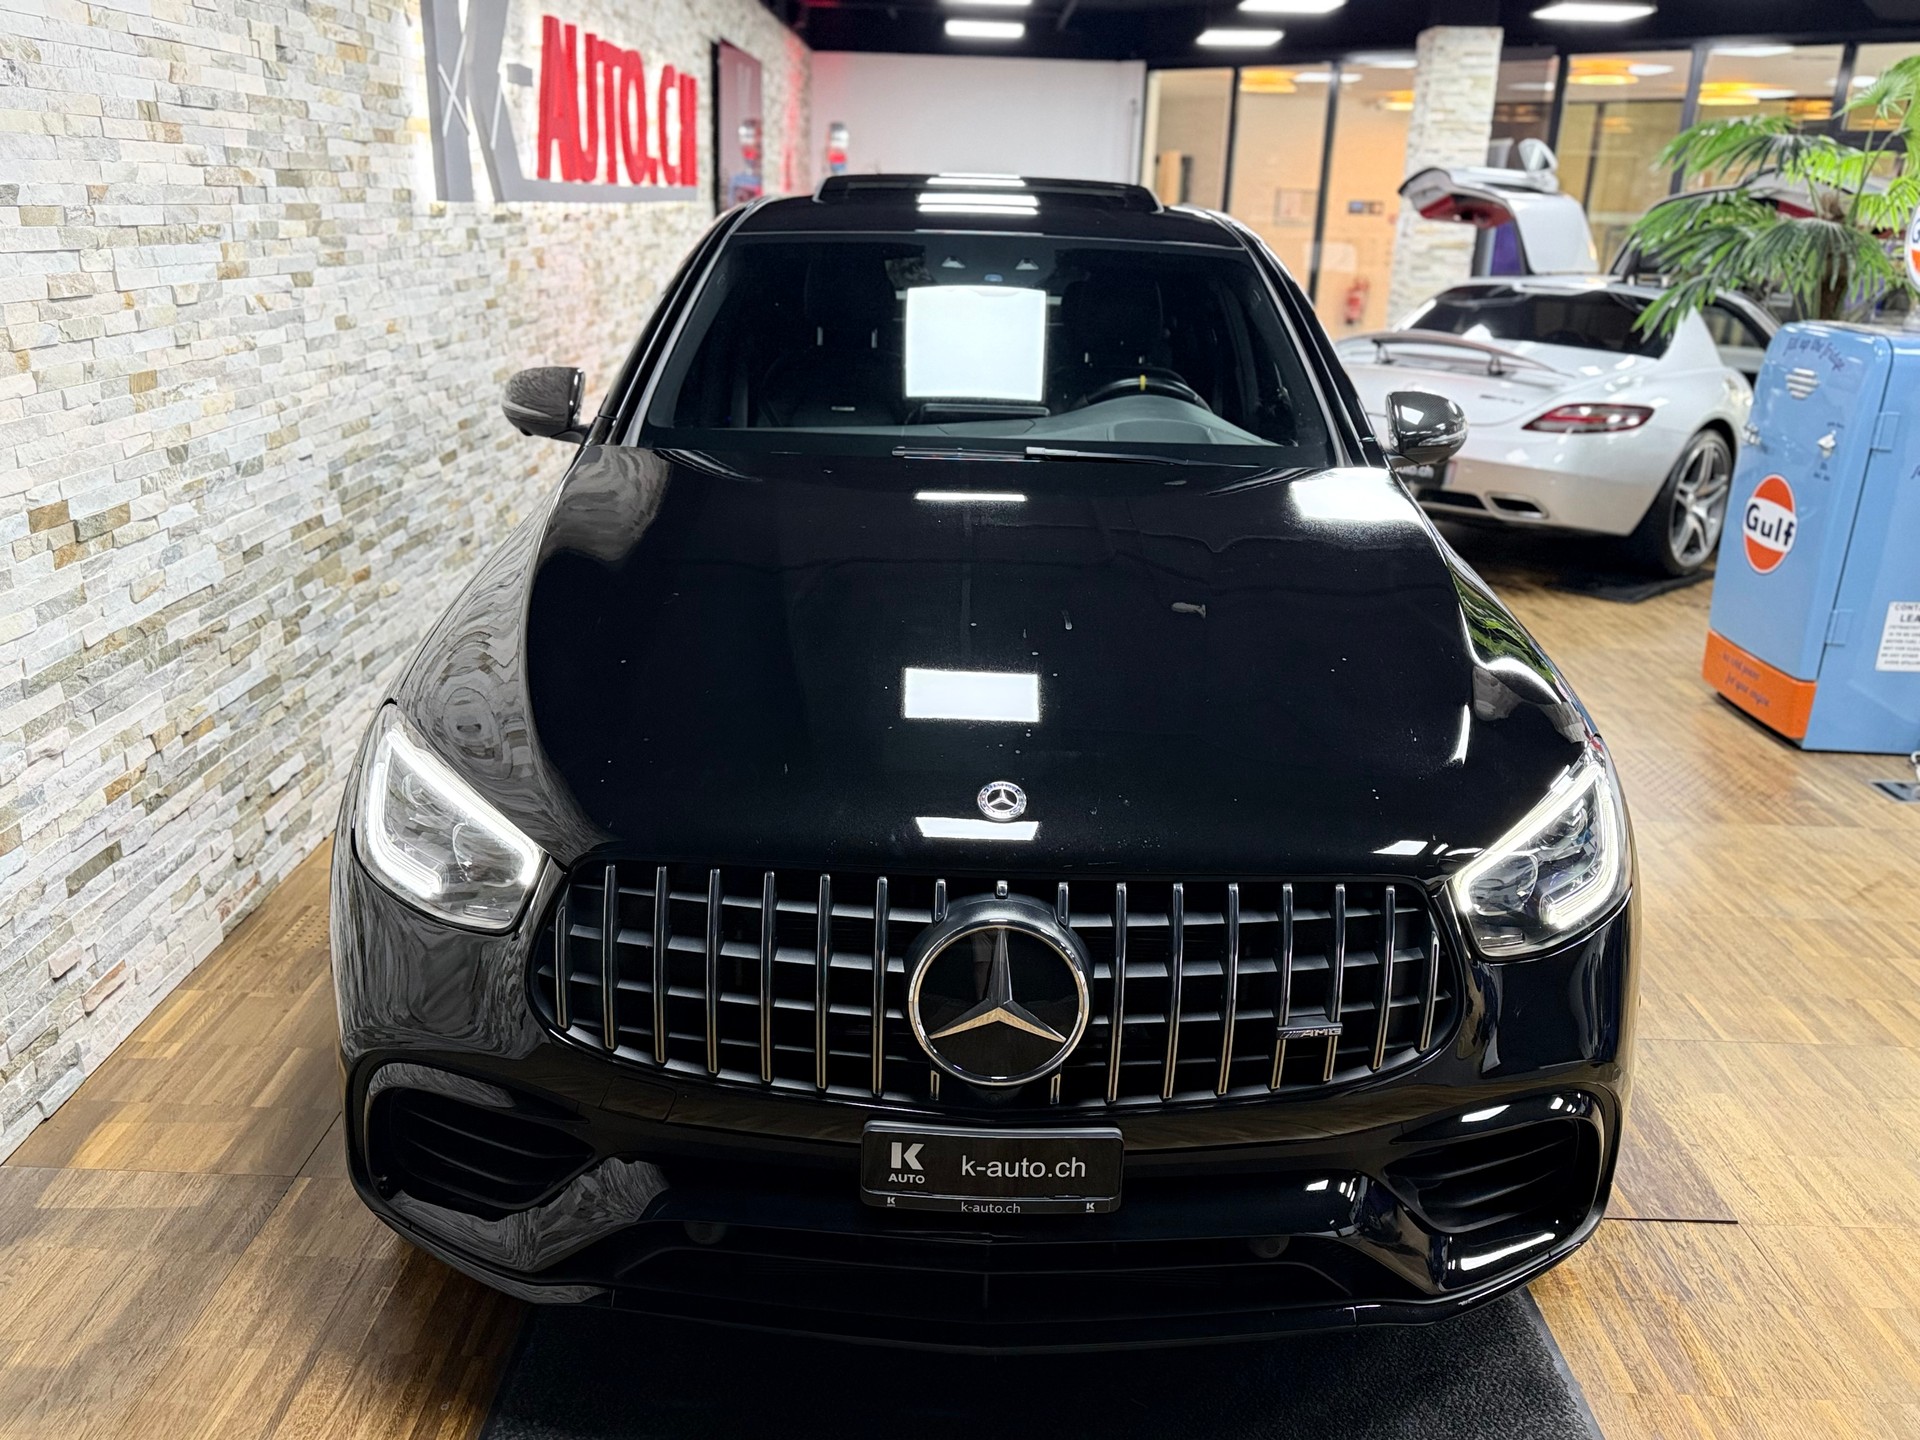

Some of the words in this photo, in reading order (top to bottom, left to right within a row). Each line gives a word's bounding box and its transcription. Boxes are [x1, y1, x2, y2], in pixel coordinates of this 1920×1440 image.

[1746, 503, 1794, 546] Gulf
[1894, 603, 1920, 611] CONT
[1300, 1028, 1342, 1037] AMG
[890, 1142, 925, 1171] K
[961, 1155, 1086, 1178] k-auto.ch
[888, 1173, 925, 1184] AUTO
[960, 1202, 1021, 1214] k-auto.ch
